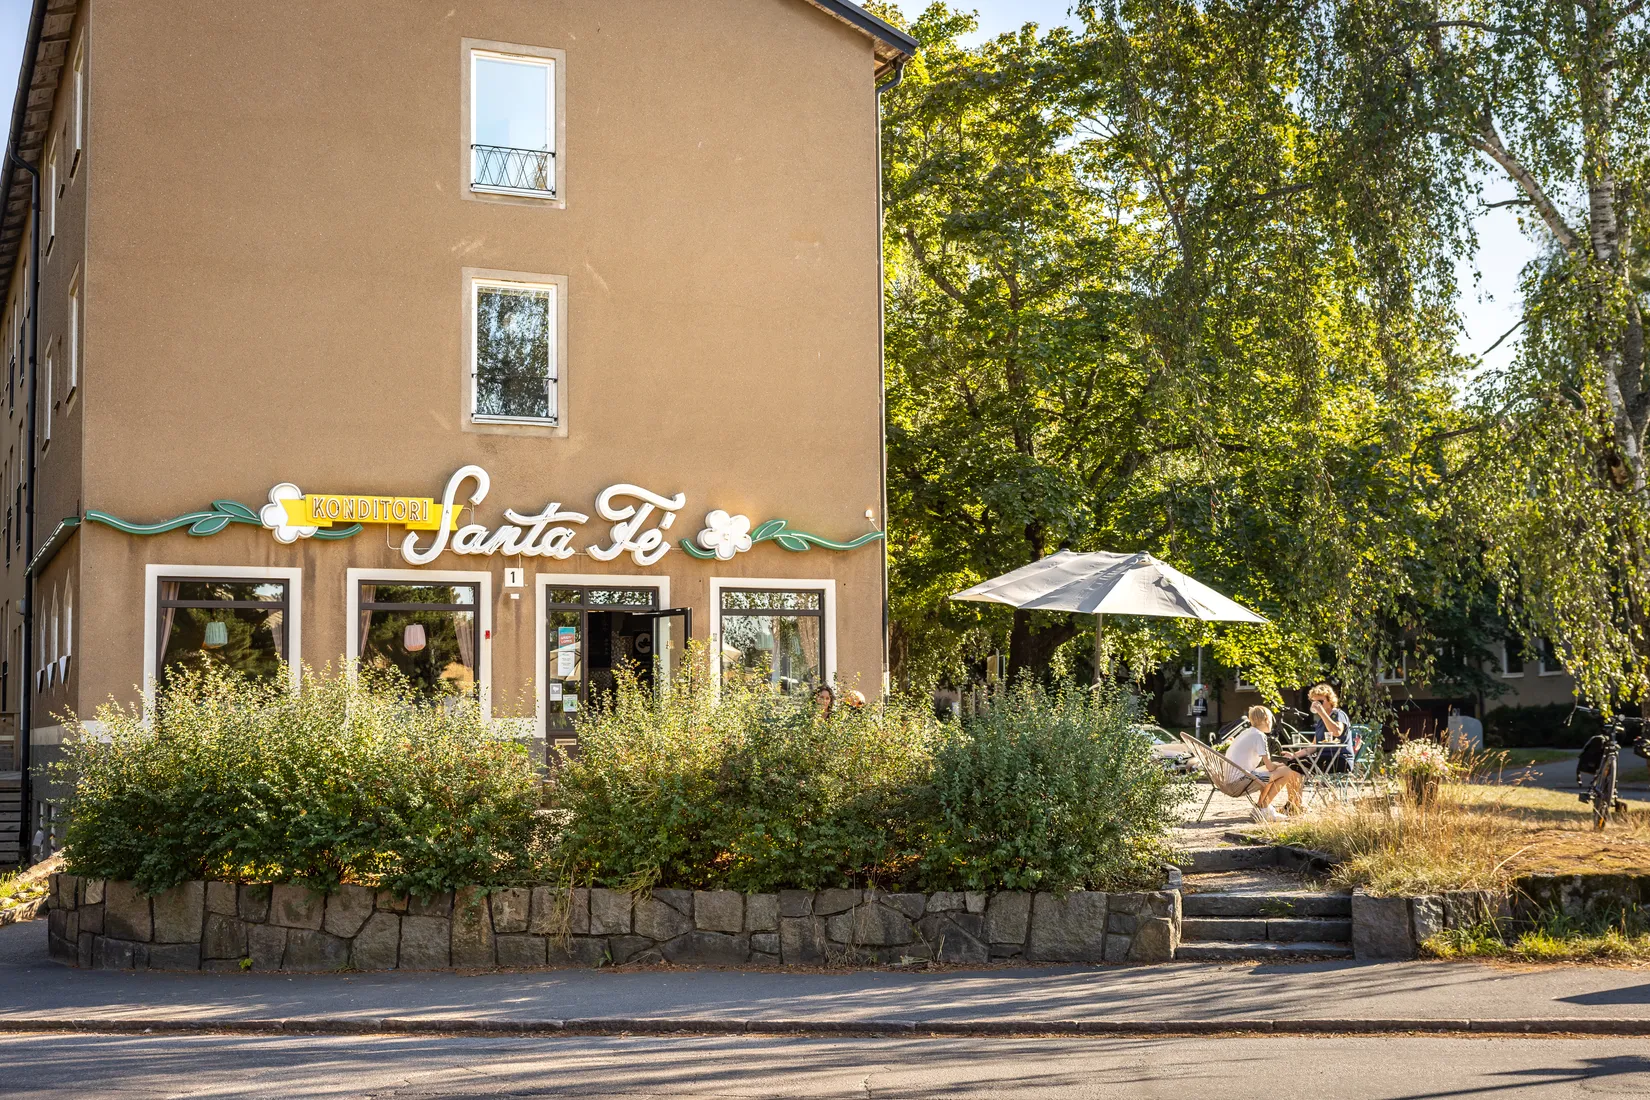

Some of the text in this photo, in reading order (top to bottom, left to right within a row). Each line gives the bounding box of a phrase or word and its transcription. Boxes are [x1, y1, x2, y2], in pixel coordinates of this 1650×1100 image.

[312, 497, 429, 521] KONDITORI
[401, 464, 686, 566] Santa Fé
[510, 571, 516, 584] 1
